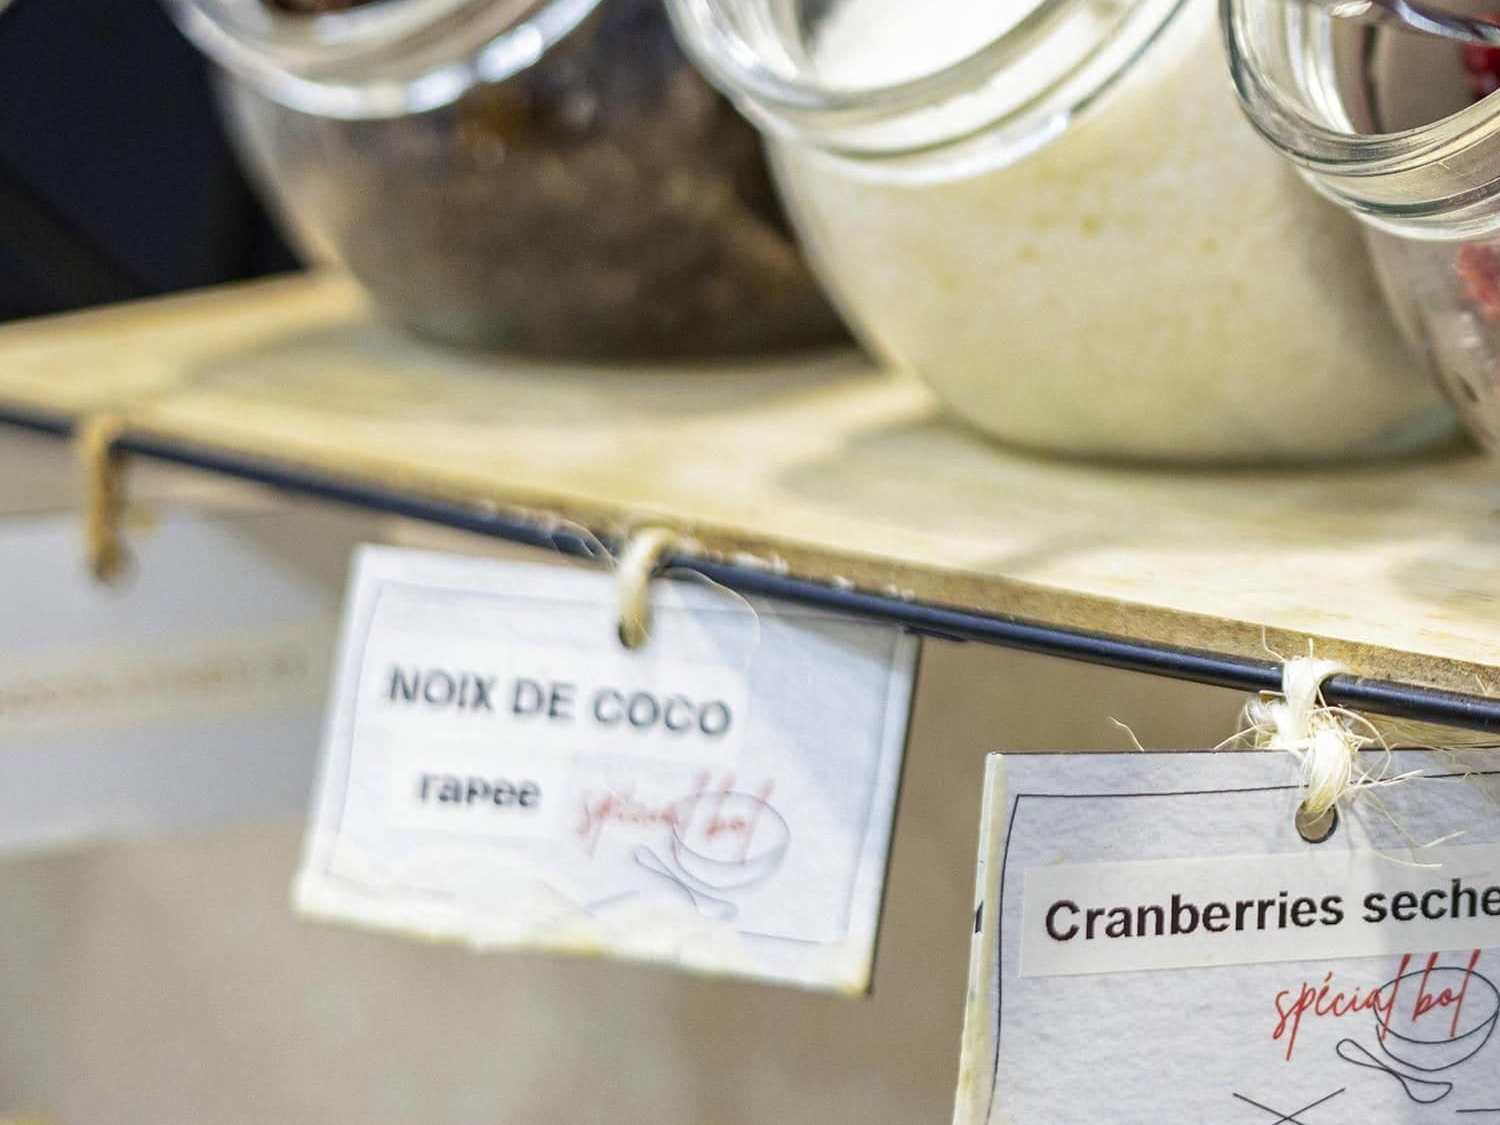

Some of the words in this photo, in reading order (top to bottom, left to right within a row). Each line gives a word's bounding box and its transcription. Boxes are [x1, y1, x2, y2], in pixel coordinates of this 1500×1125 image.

[388, 663, 497, 711] NOIX
[511, 677, 577, 718] DE
[593, 686, 733, 737] COCO
[1045, 890, 1345, 942] Cranberries
[1272, 952, 1413, 1062] spécial
[1411, 947, 1482, 1038] bol
